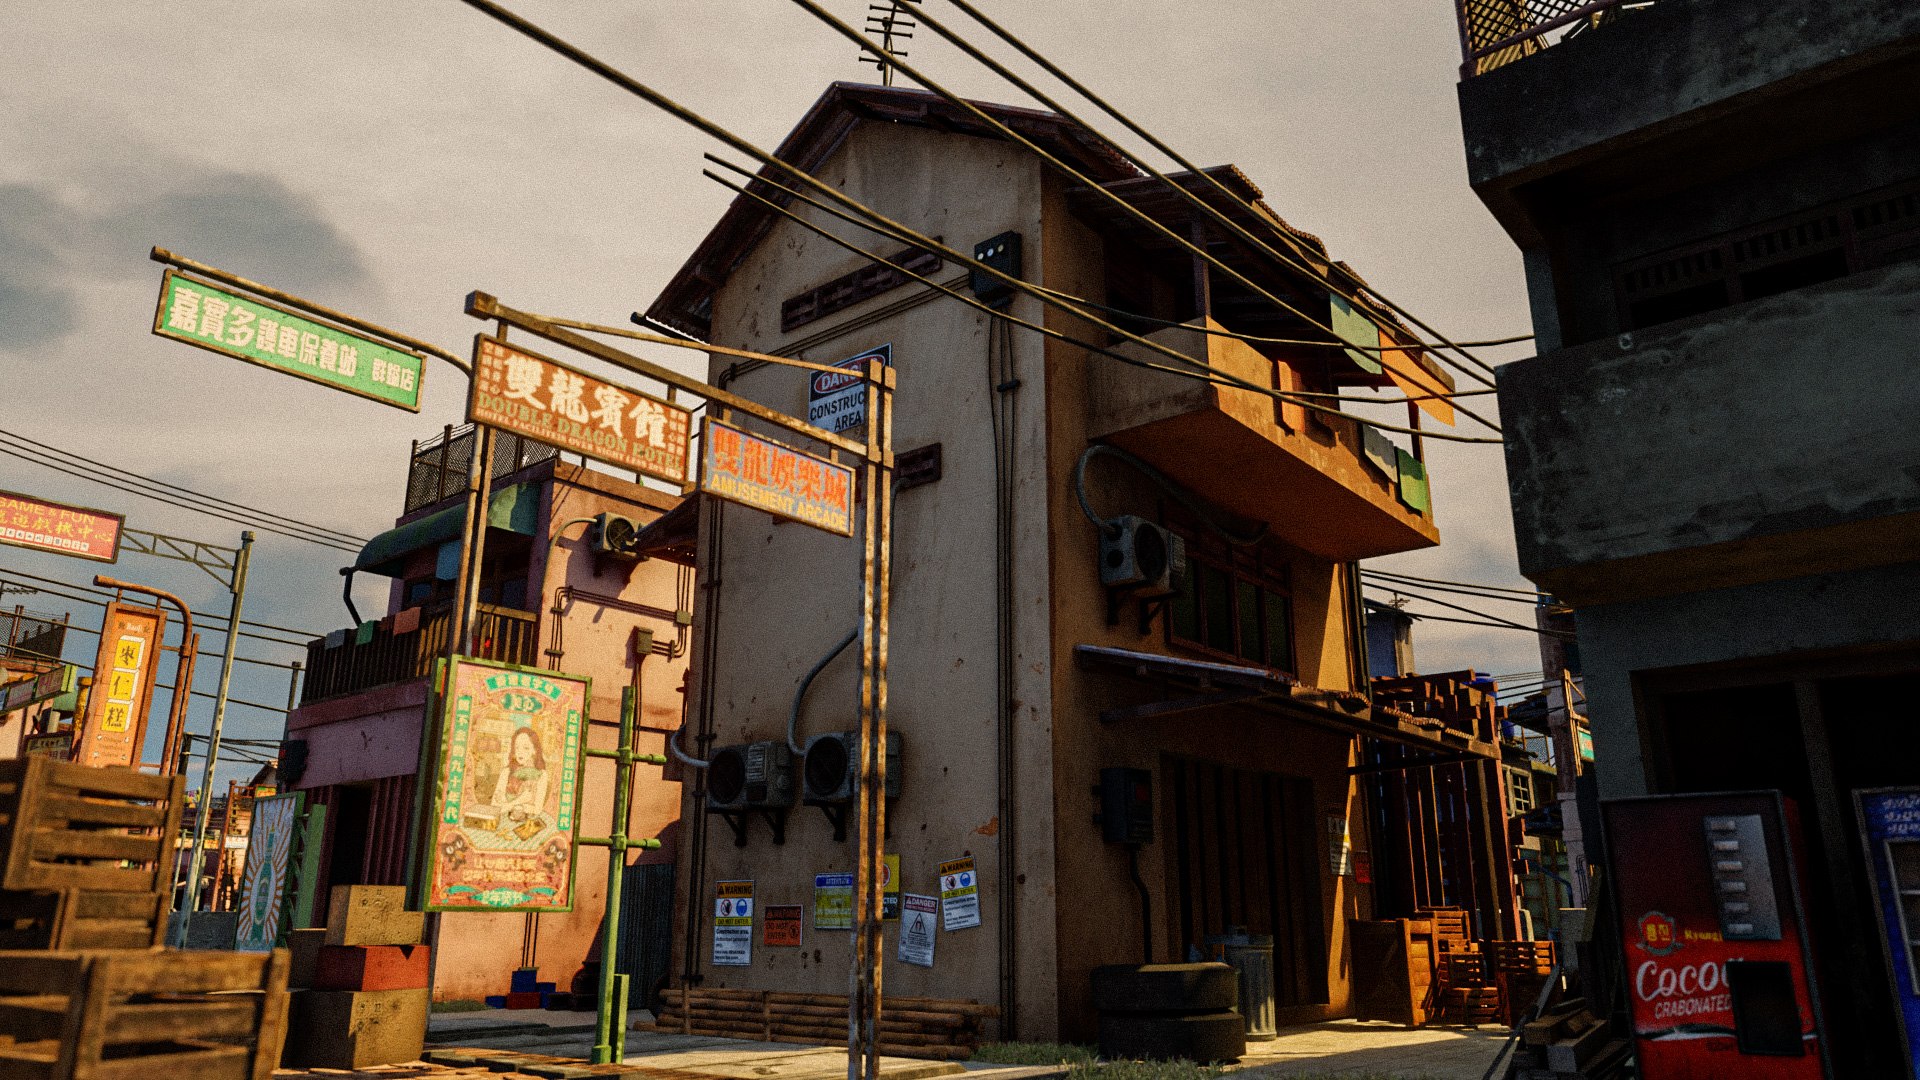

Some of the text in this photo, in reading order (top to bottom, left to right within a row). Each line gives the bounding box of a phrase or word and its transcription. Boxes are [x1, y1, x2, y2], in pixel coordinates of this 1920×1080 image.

[822, 360, 867, 391] DANG
[810, 391, 865, 421] CONSTRUC
[479, 393, 552, 426] DOUBLE
[557, 419, 629, 452] DRAGON
[632, 441, 684, 471] HOTEL
[834, 413, 862, 431] AREA
[711, 474, 847, 531] AMUSEMENT ARCADE
[60, 509, 96, 525] FUN
[725, 885, 752, 894] WARNING
[911, 898, 936, 908] DANGER
